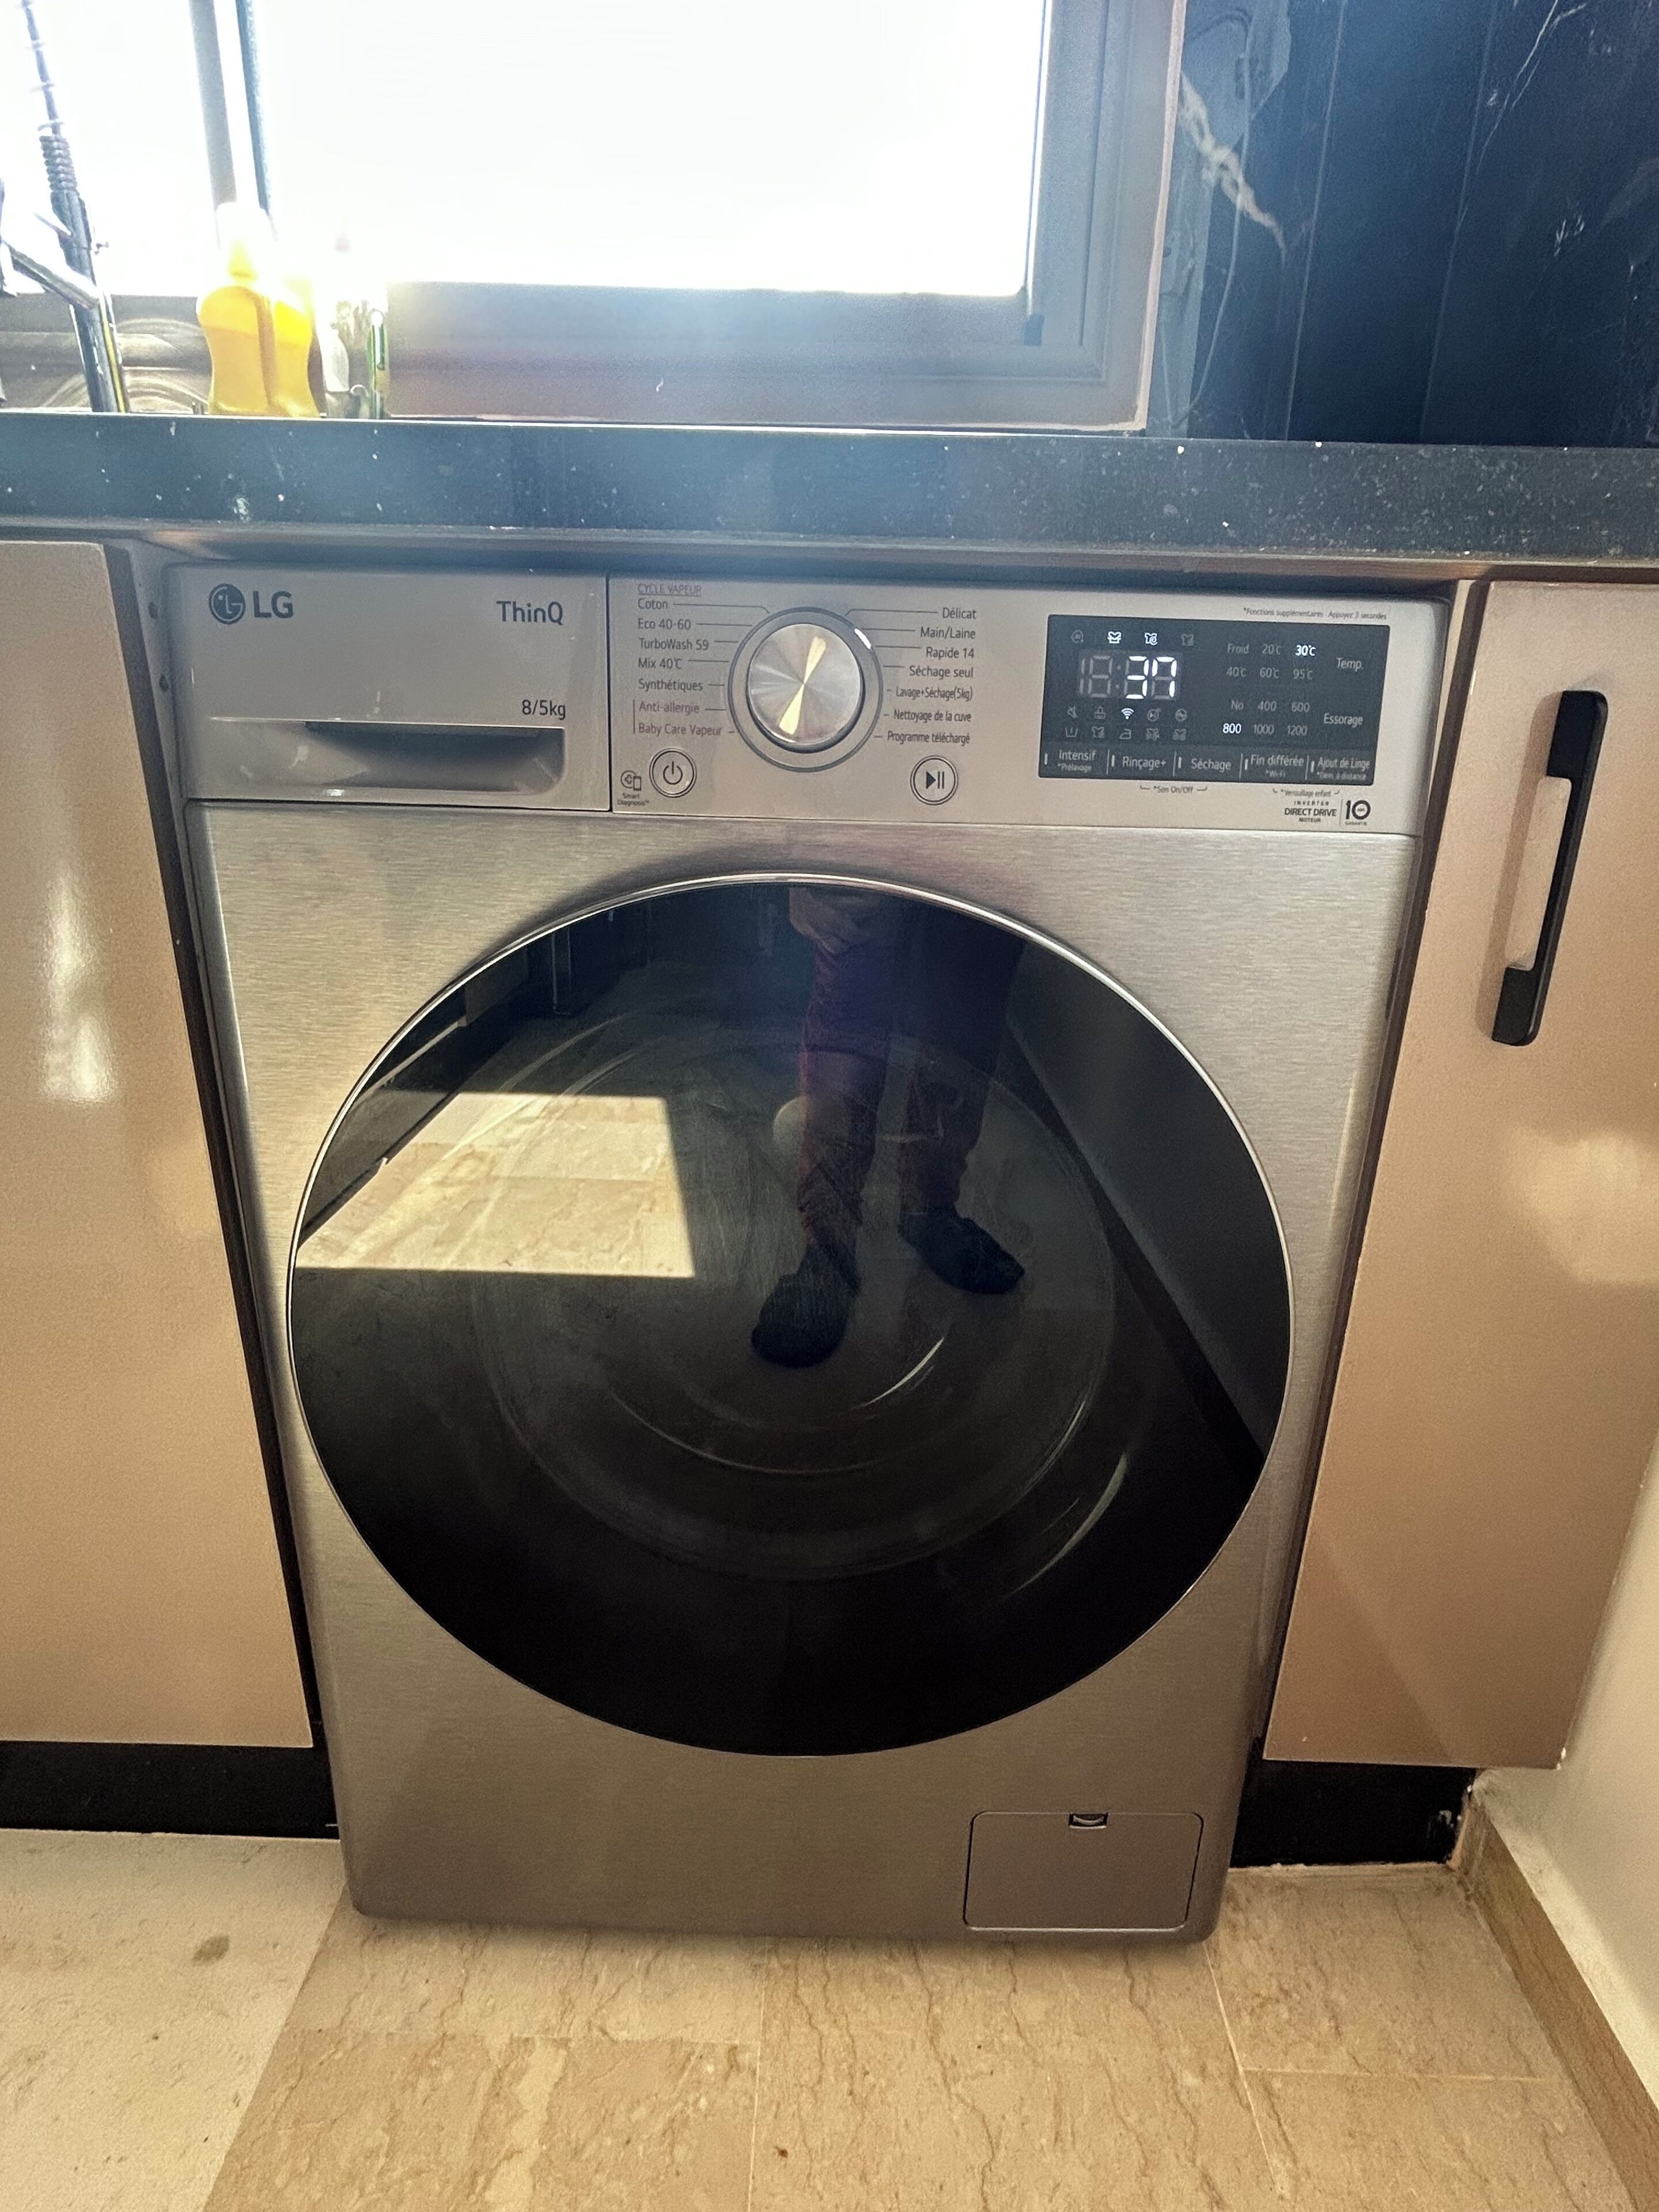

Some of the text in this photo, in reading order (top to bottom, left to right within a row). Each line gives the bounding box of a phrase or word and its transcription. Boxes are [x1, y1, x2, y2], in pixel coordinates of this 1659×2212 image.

[637, 584, 702, 595] CYCLE VAPEUR
[253, 590, 294, 618] LG
[638, 598, 668, 609] Coton
[496, 601, 563, 626] ThinQ
[942, 607, 977, 619] Délicat
[638, 618, 691, 630] Eco 40-60
[920, 626, 976, 639] Main/Laine
[639, 638, 709, 650] TurboWash 59
[1228, 643, 1249, 654] Froid
[926, 646, 974, 660] Rapide 14
[638, 657, 657, 669] Mix
[909, 665, 974, 680] Séchage seul
[638, 678, 703, 694] Synthétiques
[896, 685, 974, 702] Lavage+Séchage(5kg)
[522, 699, 566, 720] 8/5kg
[639, 701, 700, 716] Anti-allergie
[1231, 699, 1310, 713] No 400 600
[893, 709, 972, 724] Nettoyage de la cuve
[1323, 713, 1363, 728] Essorage
[638, 723, 722, 737] Baby Care Vapeur
[1222, 723, 1308, 736] 800 1000 1200
[887, 730, 971, 747] Programme téléchargé
[1059, 749, 1097, 761] Intensif
[1250, 753, 1305, 767] Fin différée
[1122, 755, 1167, 771] Rinçage+
[1191, 757, 1232, 772] Séchage
[1317, 756, 1370, 772] Ajout de Linge
[1171, 785, 1194, 794] On/Off
[1284, 808, 1337, 816] DIRECT DRIVE
